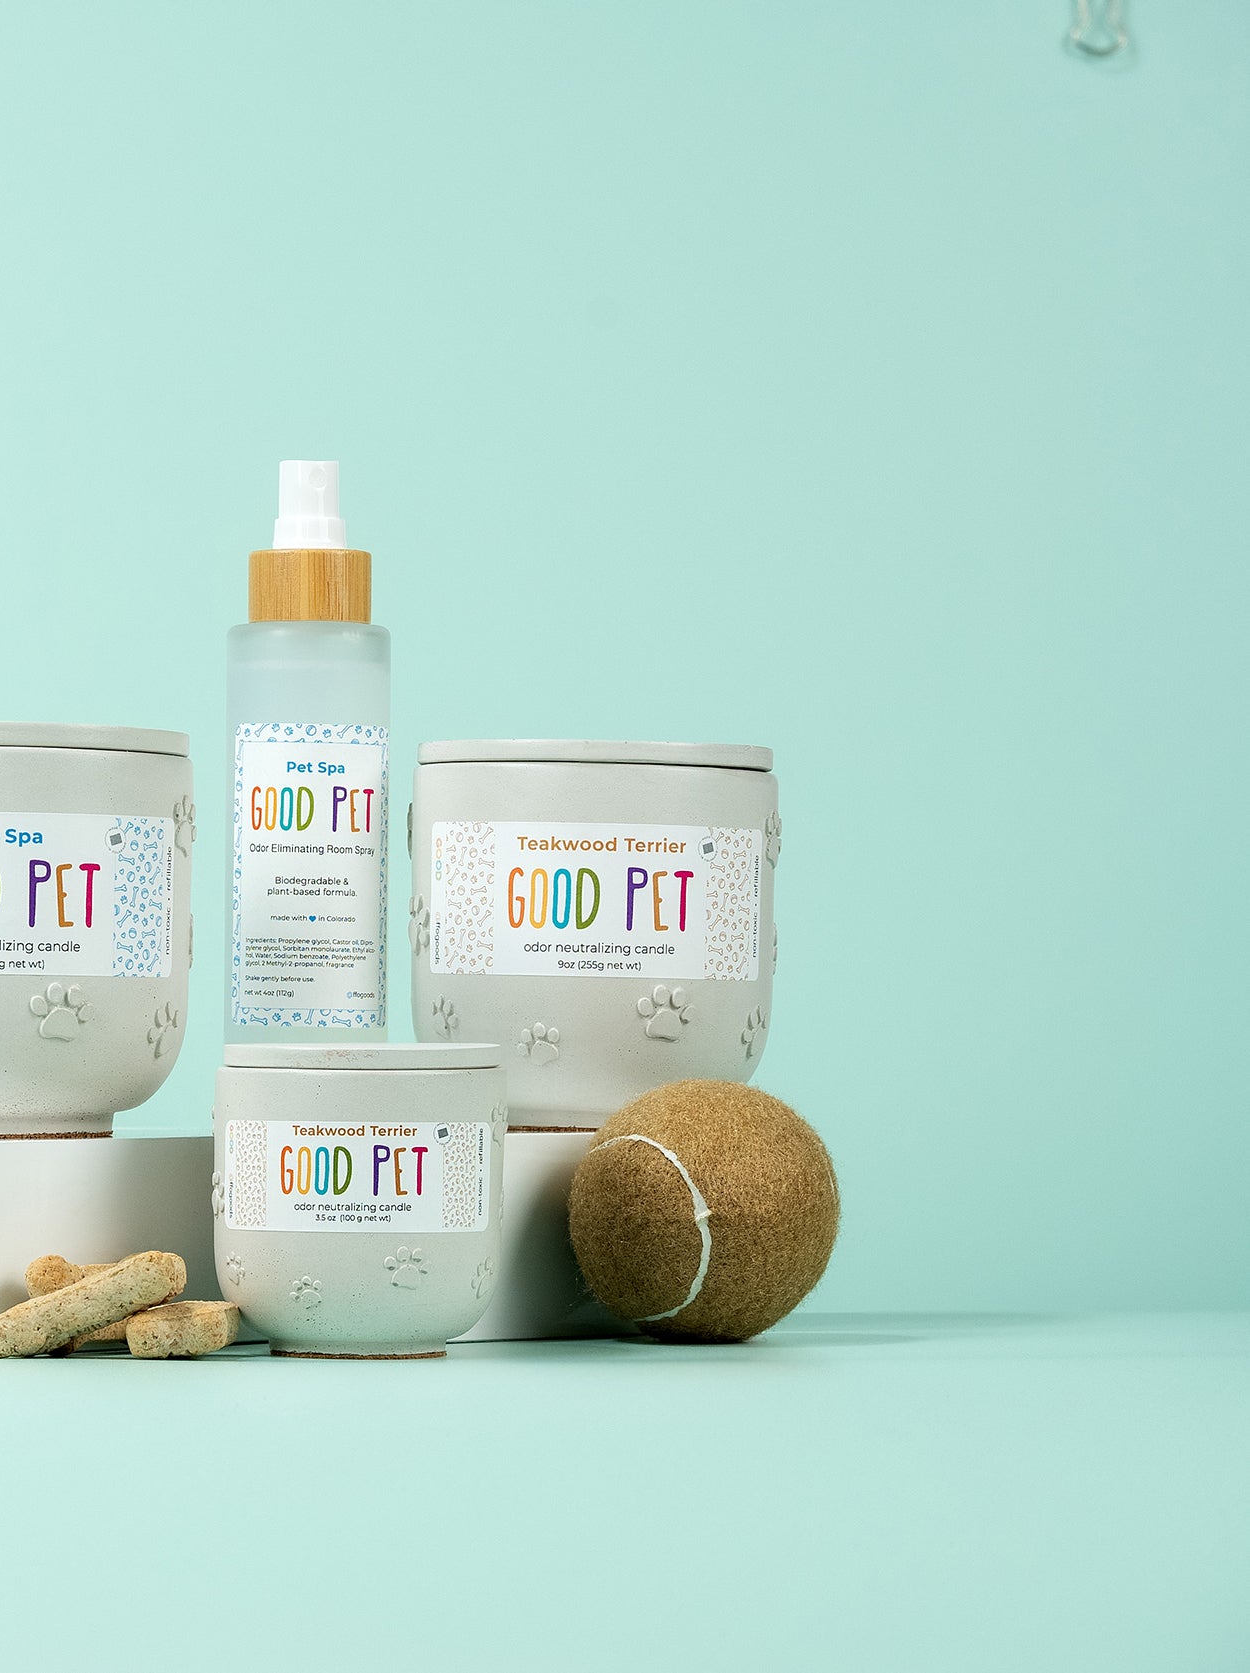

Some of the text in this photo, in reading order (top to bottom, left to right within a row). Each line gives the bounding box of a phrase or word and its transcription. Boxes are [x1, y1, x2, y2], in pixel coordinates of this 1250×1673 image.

[286, 761, 345, 776] Pet Spa
[252, 786, 374, 832] GOOD PET
[5, 829, 43, 848] Spa
[250, 844, 375, 857] Odor Eliminating Room Spray
[517, 836, 617, 852] Teakwood
[624, 837, 687, 854] Terrier
[275, 876, 349, 886] Biodegradable &
[28, 860, 101, 928] PET
[267, 888, 358, 897] plant-based formula.
[508, 867, 695, 932] GOOD PET
[38, 940, 81, 953] candle
[278, 937, 310, 946] Propylene
[524, 942, 676, 957] odor neutralizing candle
[274, 953, 298, 961] Sodium
[300, 953, 331, 962] benzoate,
[332, 954, 367, 964] Polyethylene
[8, 960, 26, 969] net
[28, 960, 45, 971] wt)
[326, 962, 355, 970] fragrance
[558, 960, 642, 972] 9oz (255g net wt)
[246, 974, 260, 982] Shake
[261, 975, 280, 983] gently
[276, 989, 294, 998] (112g)
[292, 1125, 365, 1137] Teakwood
[370, 1125, 418, 1137] Terrier
[280, 1144, 429, 1196] GOOD PET
[294, 1202, 412, 1214] odor neutralizing candle
[316, 1214, 326, 1222] 3.5
[340, 1214, 356, 1223] (100
[357, 1216, 363, 1224] g
[378, 1214, 392, 1223] wt)
